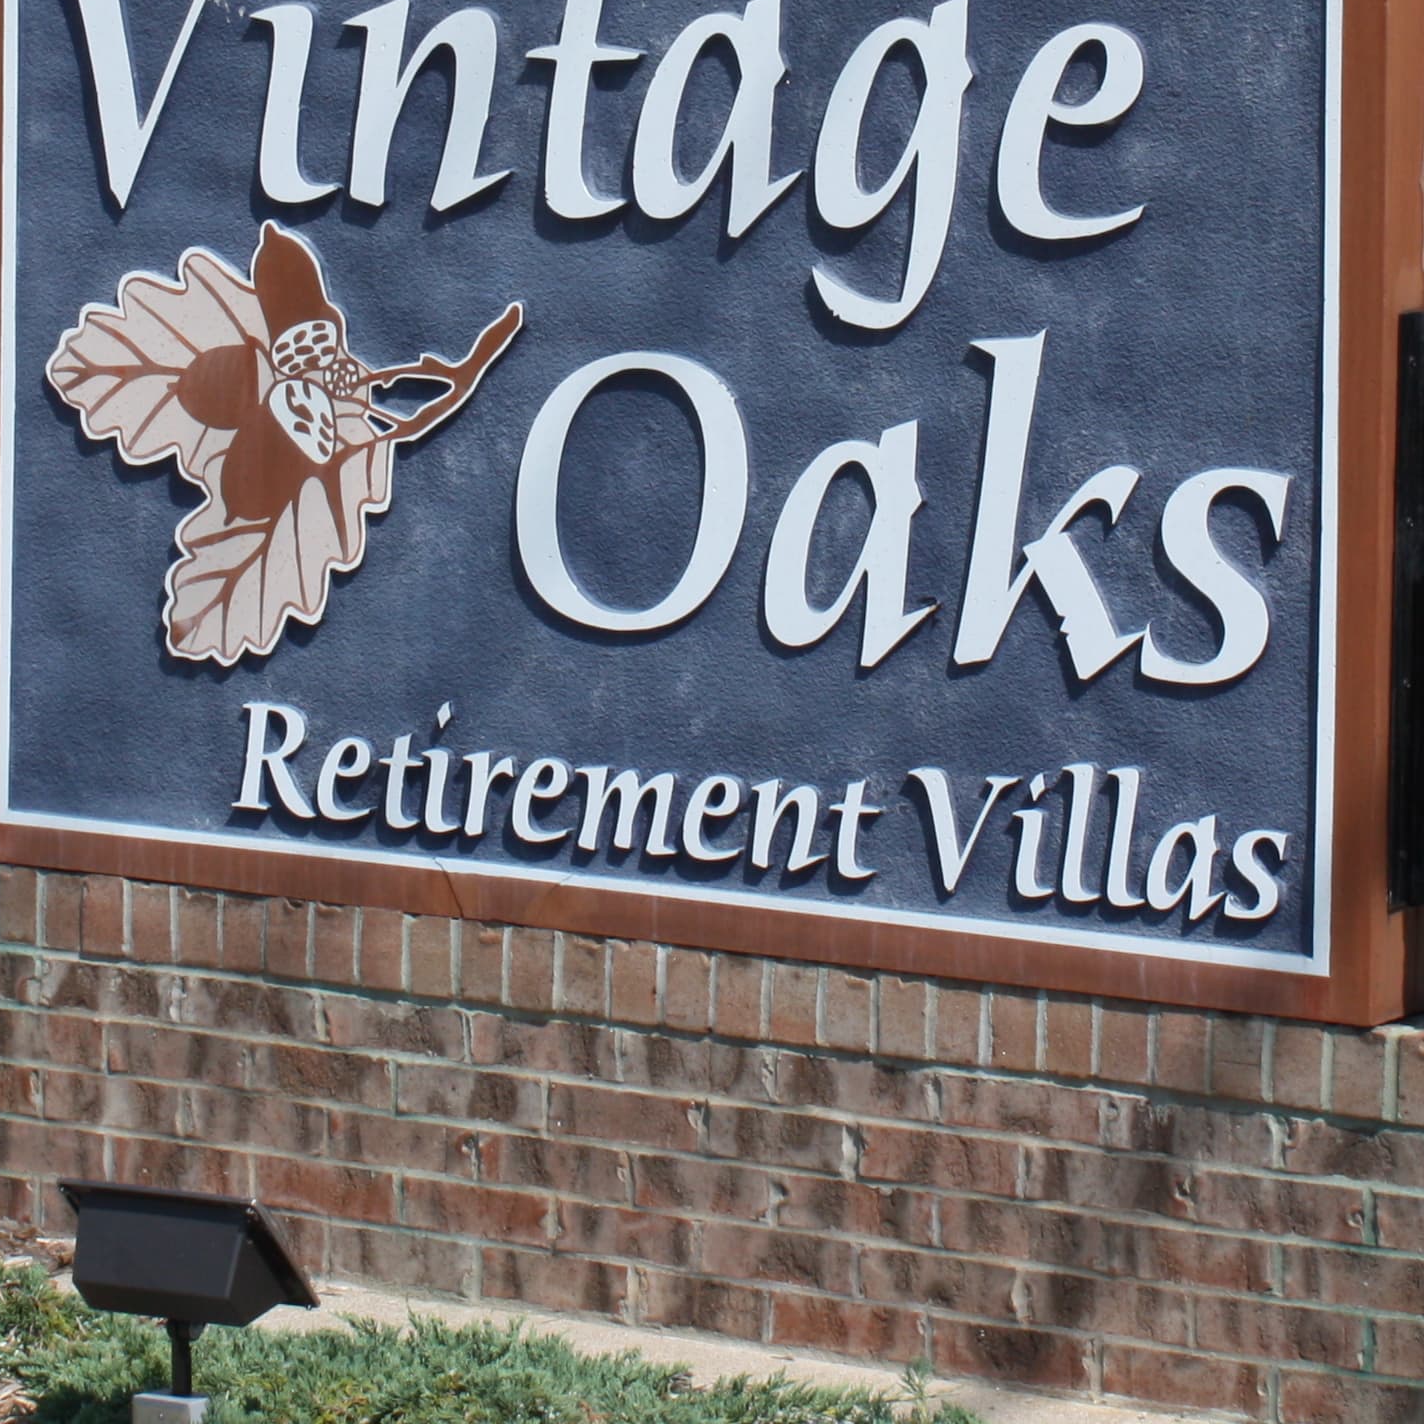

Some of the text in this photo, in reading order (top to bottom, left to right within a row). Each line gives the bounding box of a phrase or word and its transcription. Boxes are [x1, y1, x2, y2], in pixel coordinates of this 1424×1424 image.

[515, 328, 1293, 686] Oaks
[231, 700, 1289, 922] Retirement Villas
